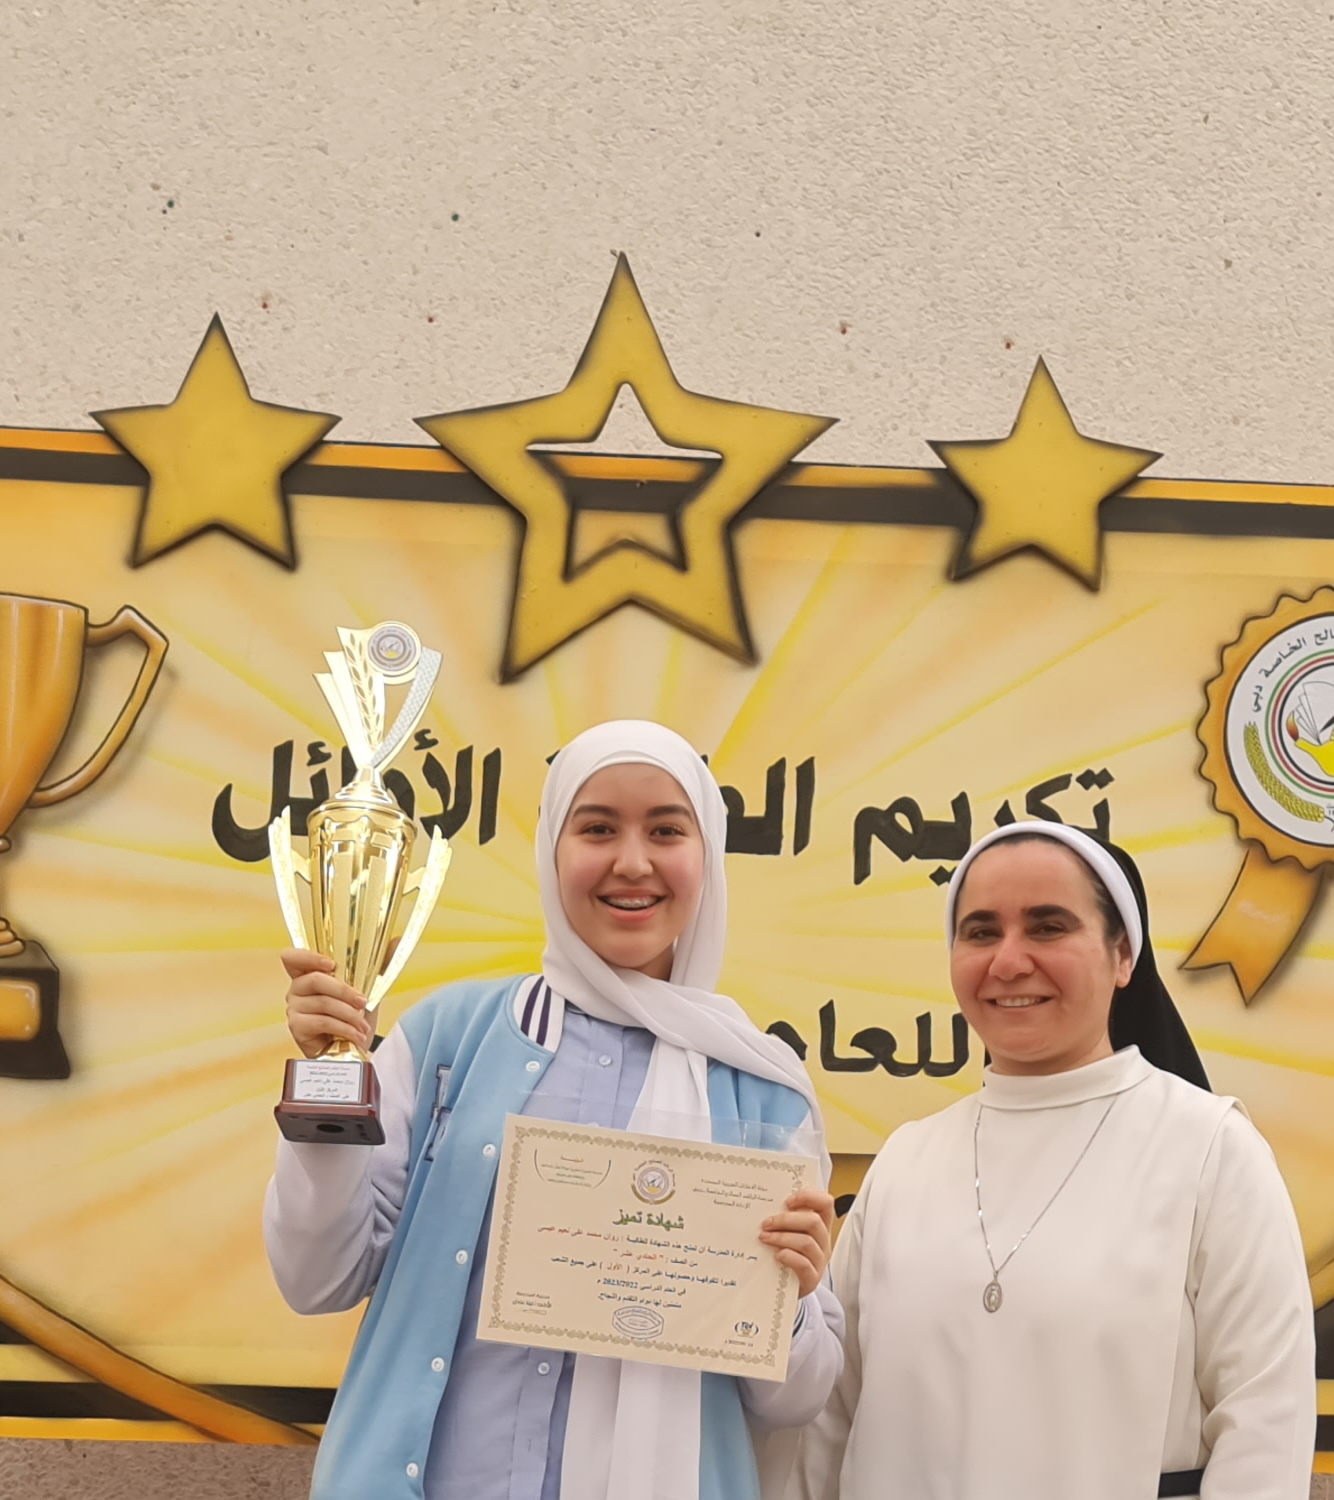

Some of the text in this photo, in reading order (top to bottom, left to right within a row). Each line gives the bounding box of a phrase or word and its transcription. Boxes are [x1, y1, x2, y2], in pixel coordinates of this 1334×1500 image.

[1258, 636, 1307, 678] الخاصة
[1251, 684, 1264, 713] دبي
[612, 1208, 684, 1231] شهادة تميز
